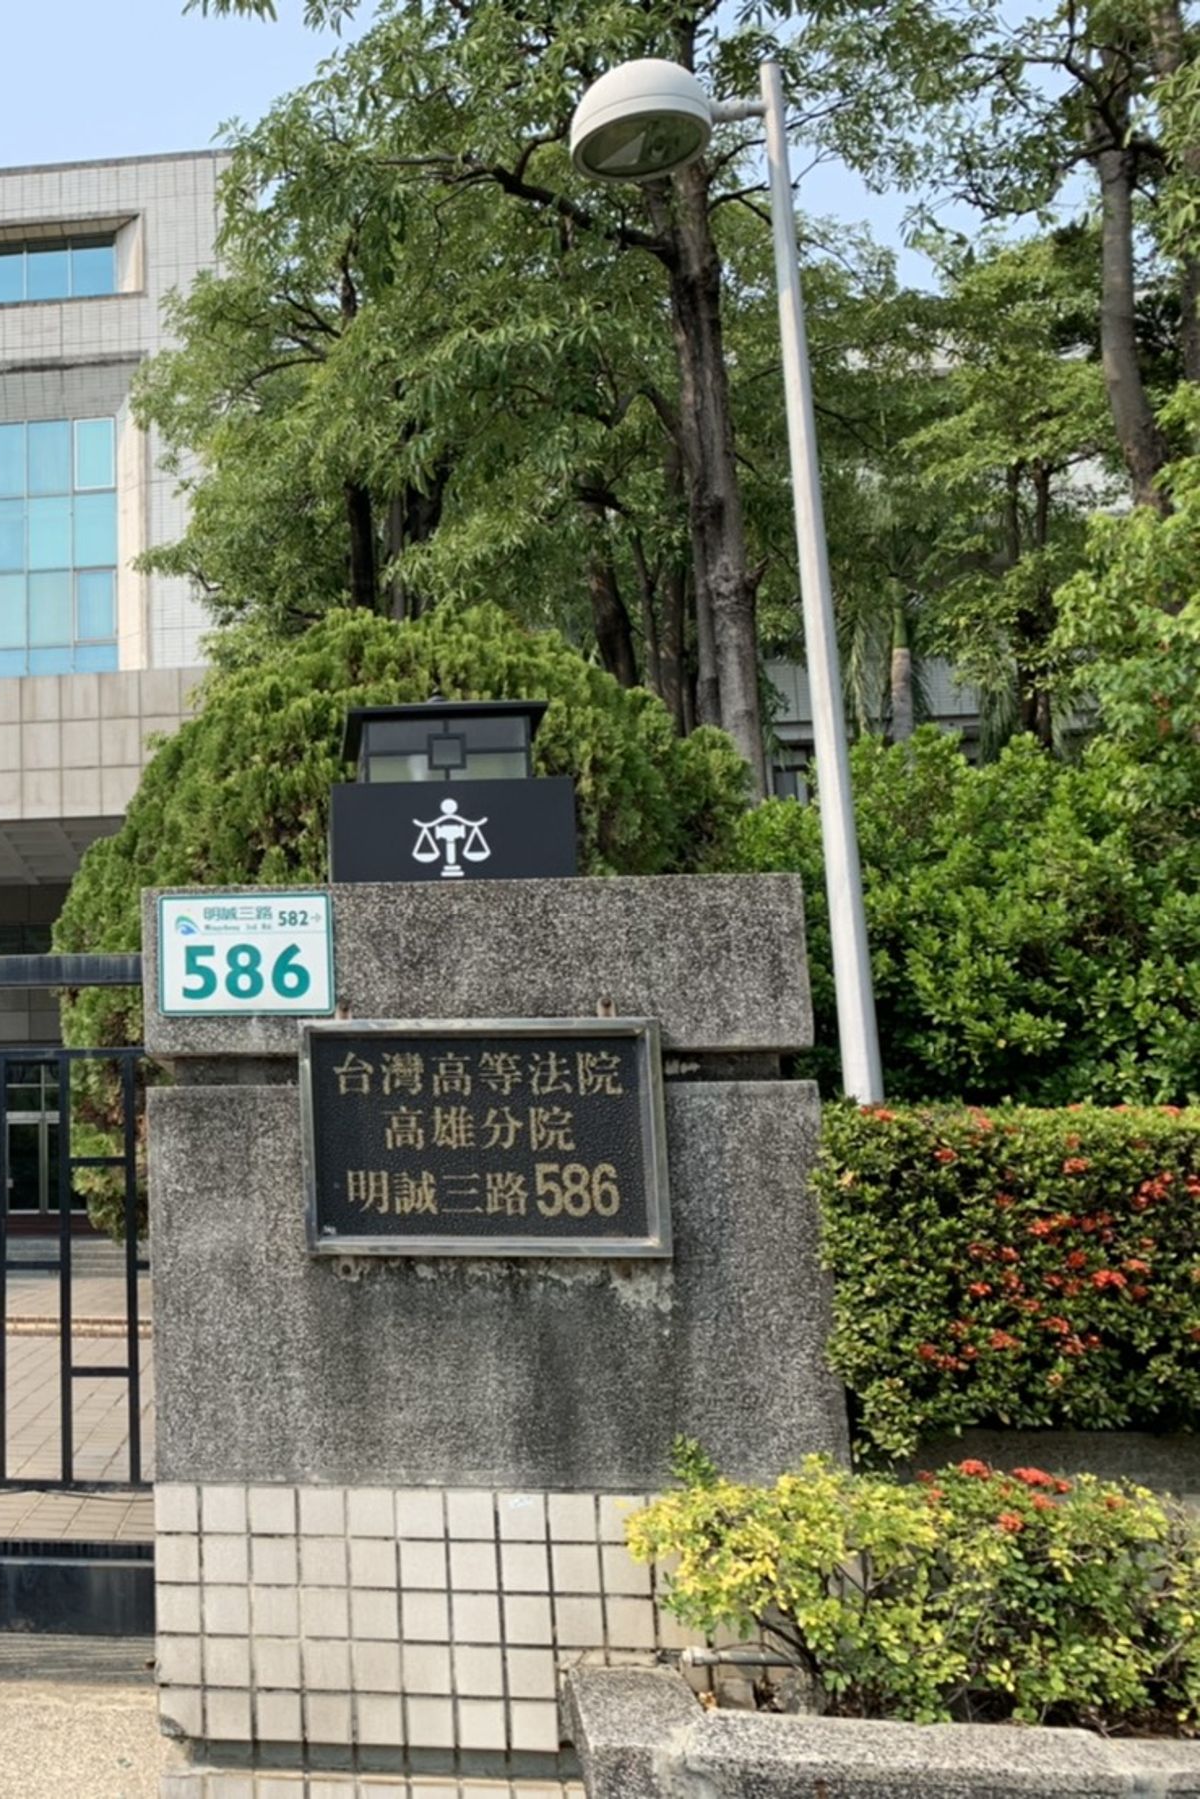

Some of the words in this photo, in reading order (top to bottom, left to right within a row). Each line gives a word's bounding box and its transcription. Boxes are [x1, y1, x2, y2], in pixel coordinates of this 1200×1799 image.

[277, 910, 309, 927] 582
[181, 943, 311, 1000] 586
[333, 1051, 624, 1096] 台灣高等法院
[382, 1105, 577, 1151] 高雄分院
